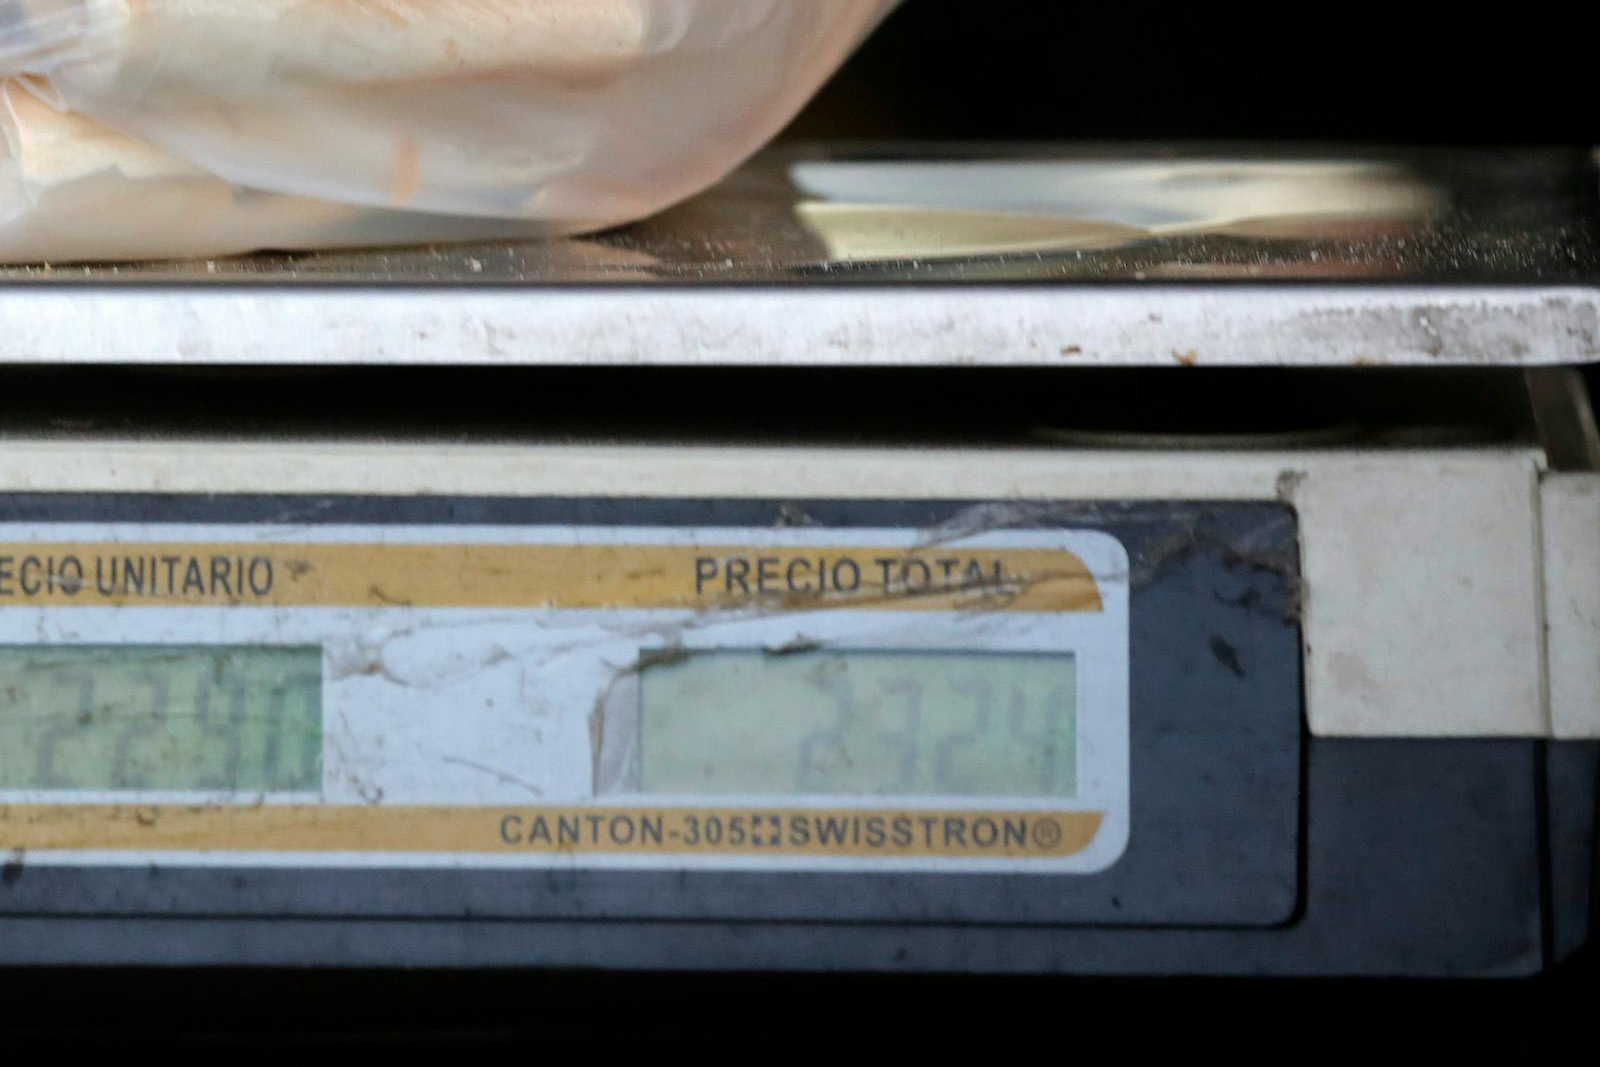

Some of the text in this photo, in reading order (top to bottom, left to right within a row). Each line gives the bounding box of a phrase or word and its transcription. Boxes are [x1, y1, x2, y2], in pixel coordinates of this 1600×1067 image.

[96, 555, 273, 596] UNITARIO
[695, 557, 861, 594] PRECIO
[500, 814, 746, 846] CANTON-305
